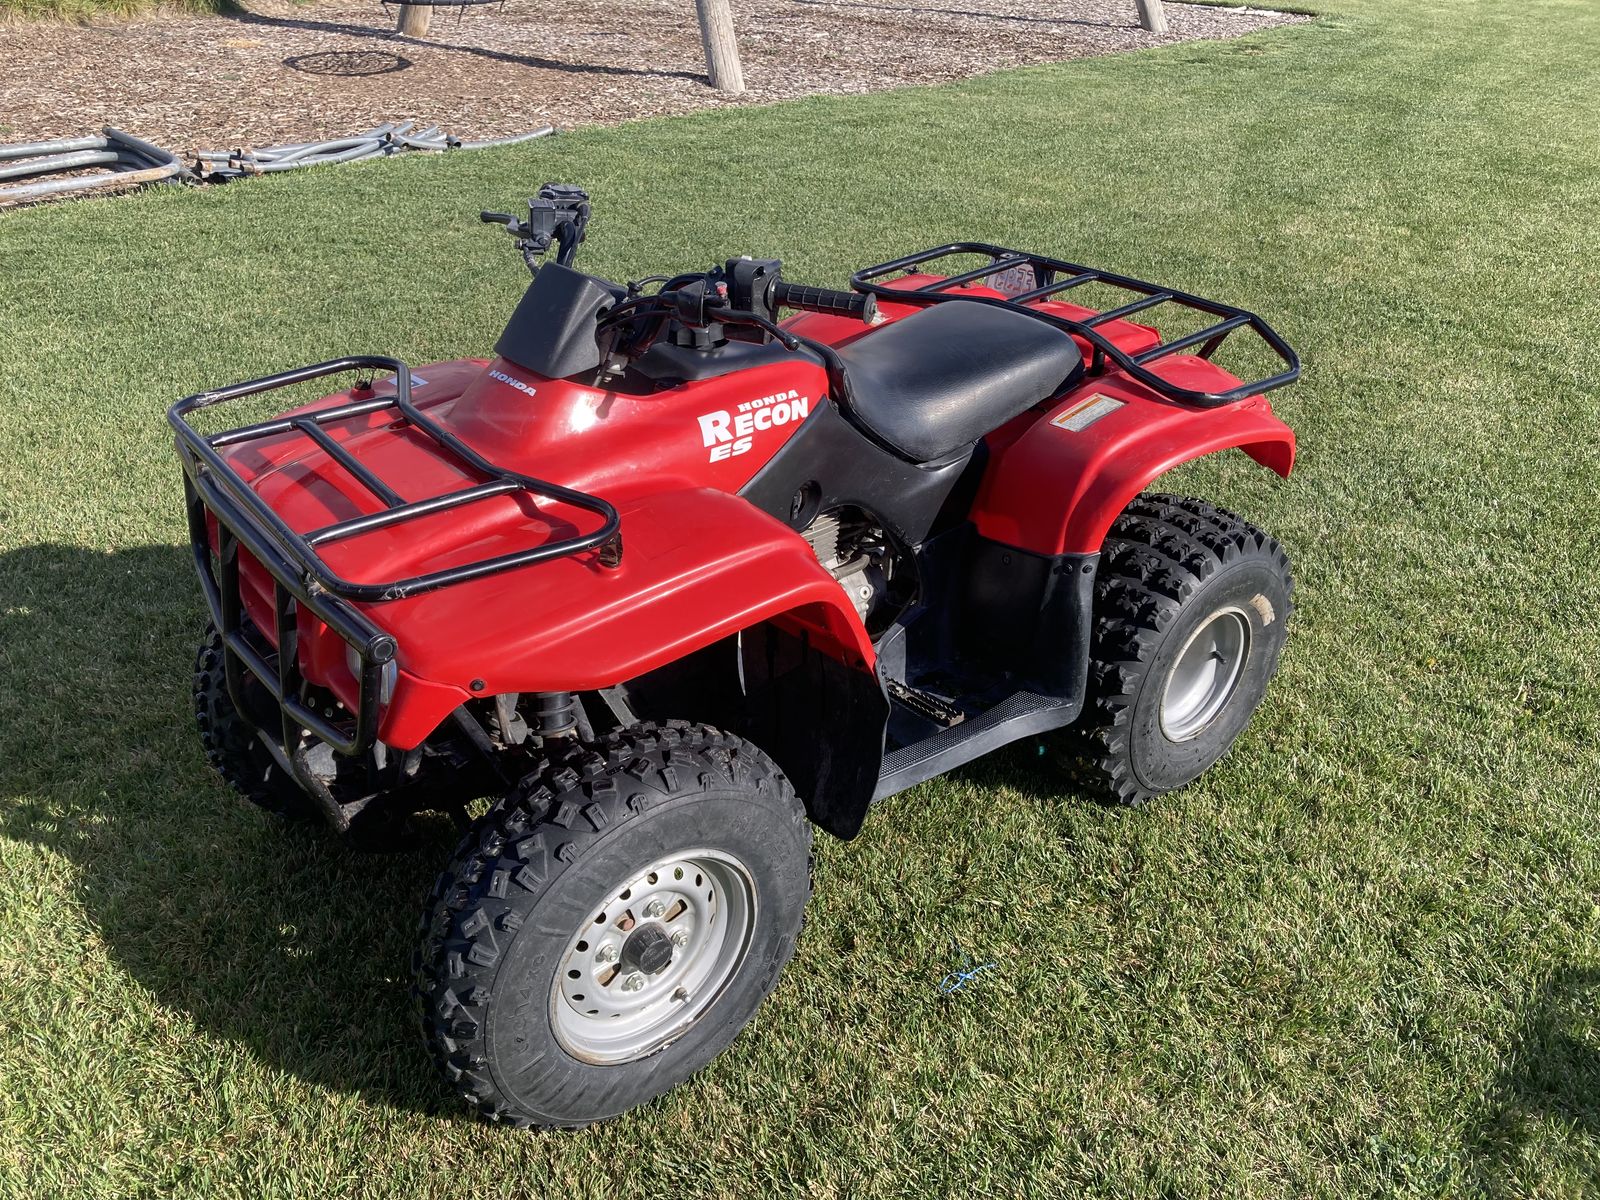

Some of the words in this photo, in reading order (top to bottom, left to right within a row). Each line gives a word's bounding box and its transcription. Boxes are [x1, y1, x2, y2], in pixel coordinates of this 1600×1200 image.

[489, 370, 537, 397] HONDA
[737, 390, 799, 412] HONDA
[697, 397, 808, 448] RECON
[709, 436, 752, 463] ES
